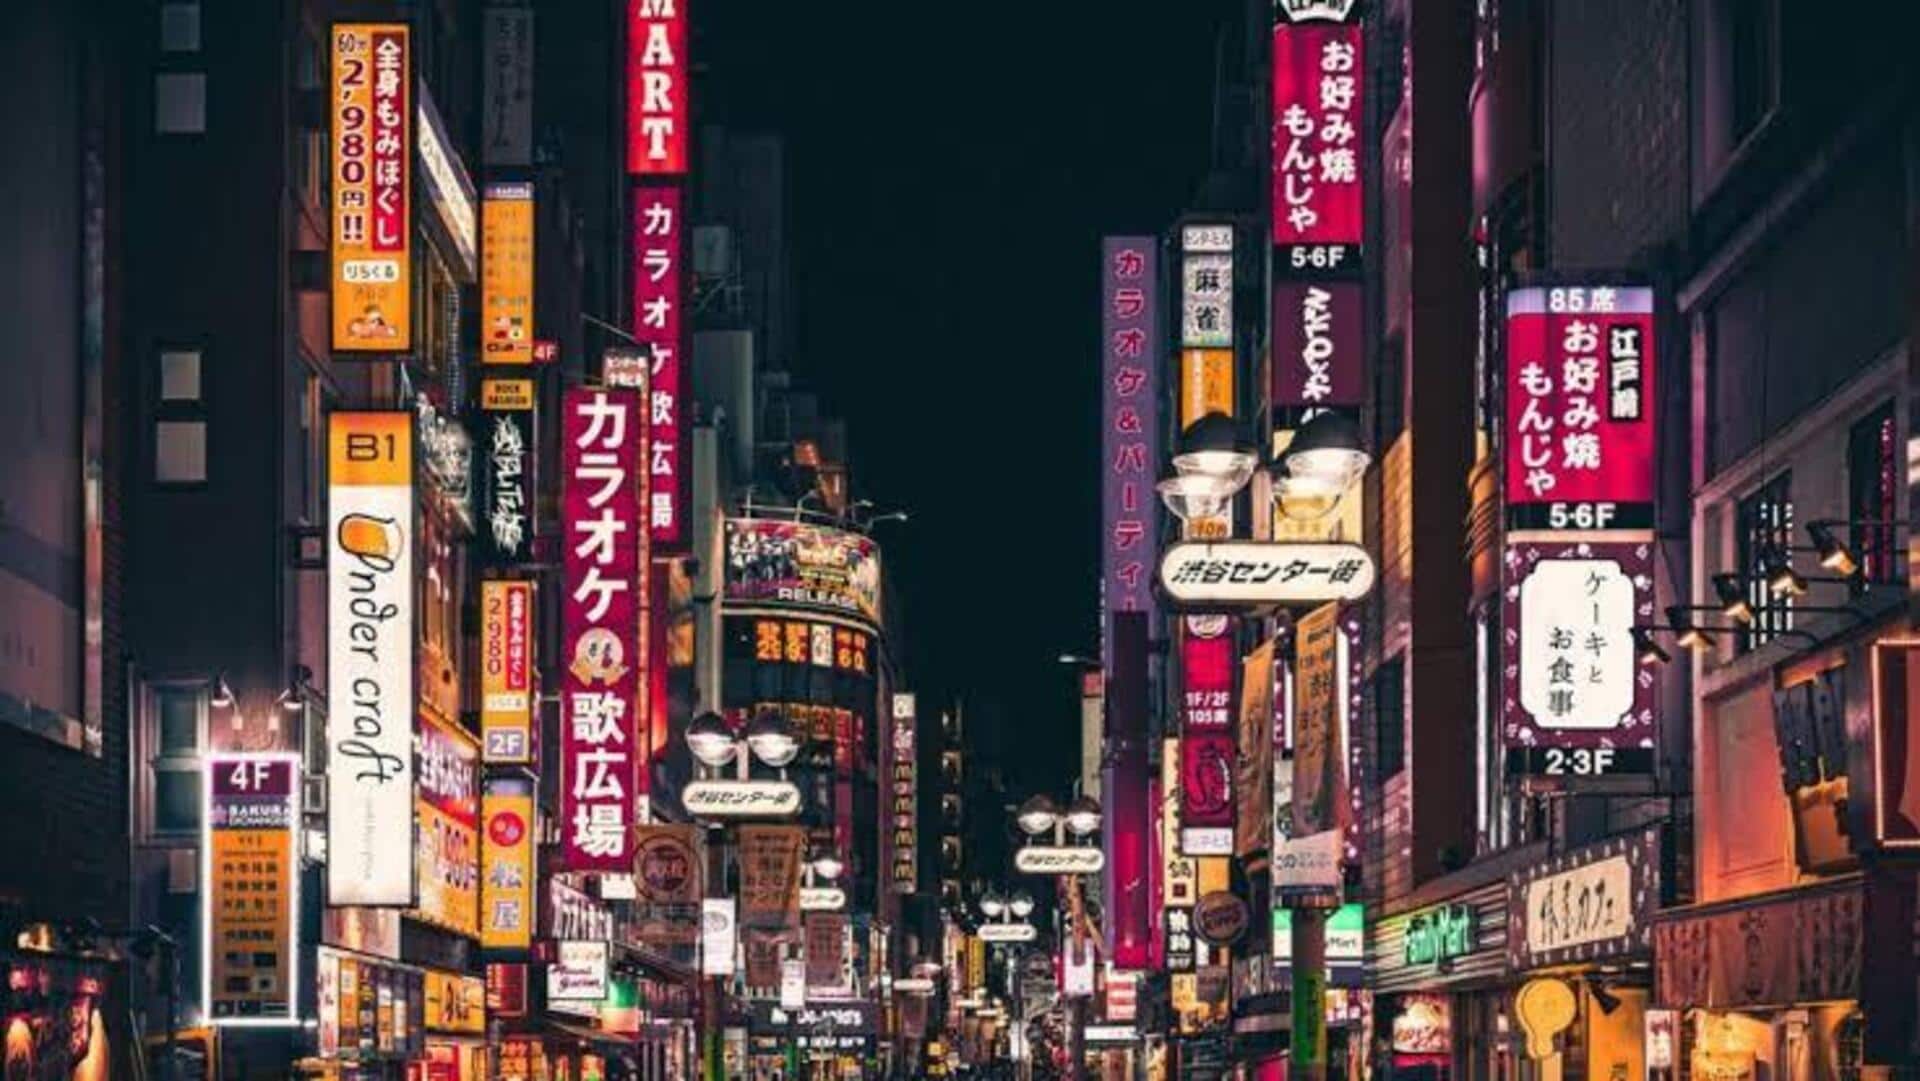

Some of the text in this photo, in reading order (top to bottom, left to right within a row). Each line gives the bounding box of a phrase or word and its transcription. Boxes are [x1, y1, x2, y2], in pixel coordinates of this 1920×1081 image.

[375, 38, 401, 245] 全身もみほぐし
[1281, 104, 1318, 233] もんじゃ
[1320, 41, 1355, 183] お好み焼
[1195, 267, 1221, 331] 麻雀
[346, 433, 395, 462] B1
[1114, 248, 1147, 612] カラオケ&パーティ
[1518, 362, 1556, 497] もんじゃ
[1563, 320, 1601, 470] お好み焼
[573, 393, 629, 624] カラオケ
[1171, 559, 1365, 585] 渋谷センター街
[1584, 570, 1609, 684] ケーキと
[338, 677, 405, 785] craft
[1548, 627, 1575, 717] お食事
[229, 761, 271, 791] 4F
[490, 734, 521, 754] 2F
[573, 692, 627, 857] 歌広場
